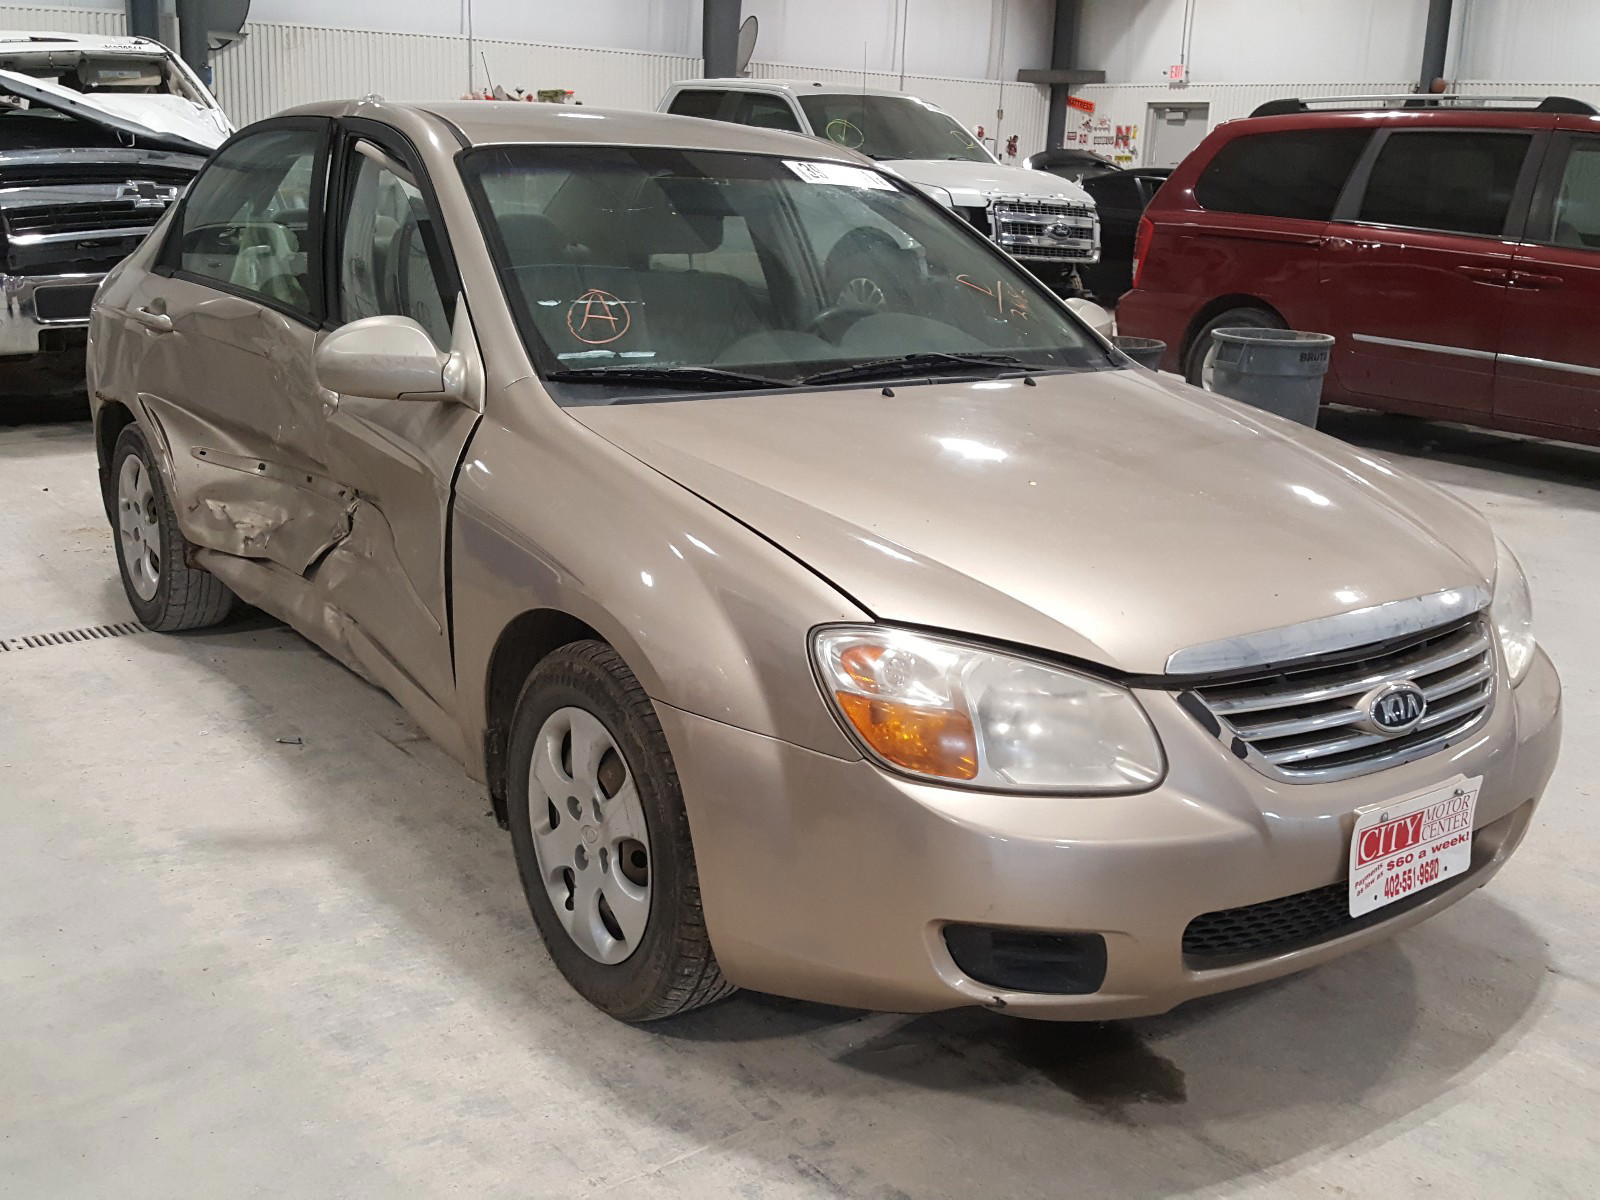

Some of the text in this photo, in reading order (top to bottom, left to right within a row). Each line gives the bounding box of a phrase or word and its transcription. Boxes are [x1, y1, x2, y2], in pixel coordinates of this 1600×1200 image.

[1170, 65, 1185, 79] EXIT
[578, 293, 619, 333] A
[1380, 693, 1420, 724] KIA
[1424, 795, 1471, 823] MOTOR
[1360, 813, 1423, 861] CITY
[1421, 812, 1470, 841] CENTER
[1386, 831, 1470, 872] $60 a week!
[1354, 863, 1383, 889] Payments
[1384, 858, 1440, 899] 402-551-9620
